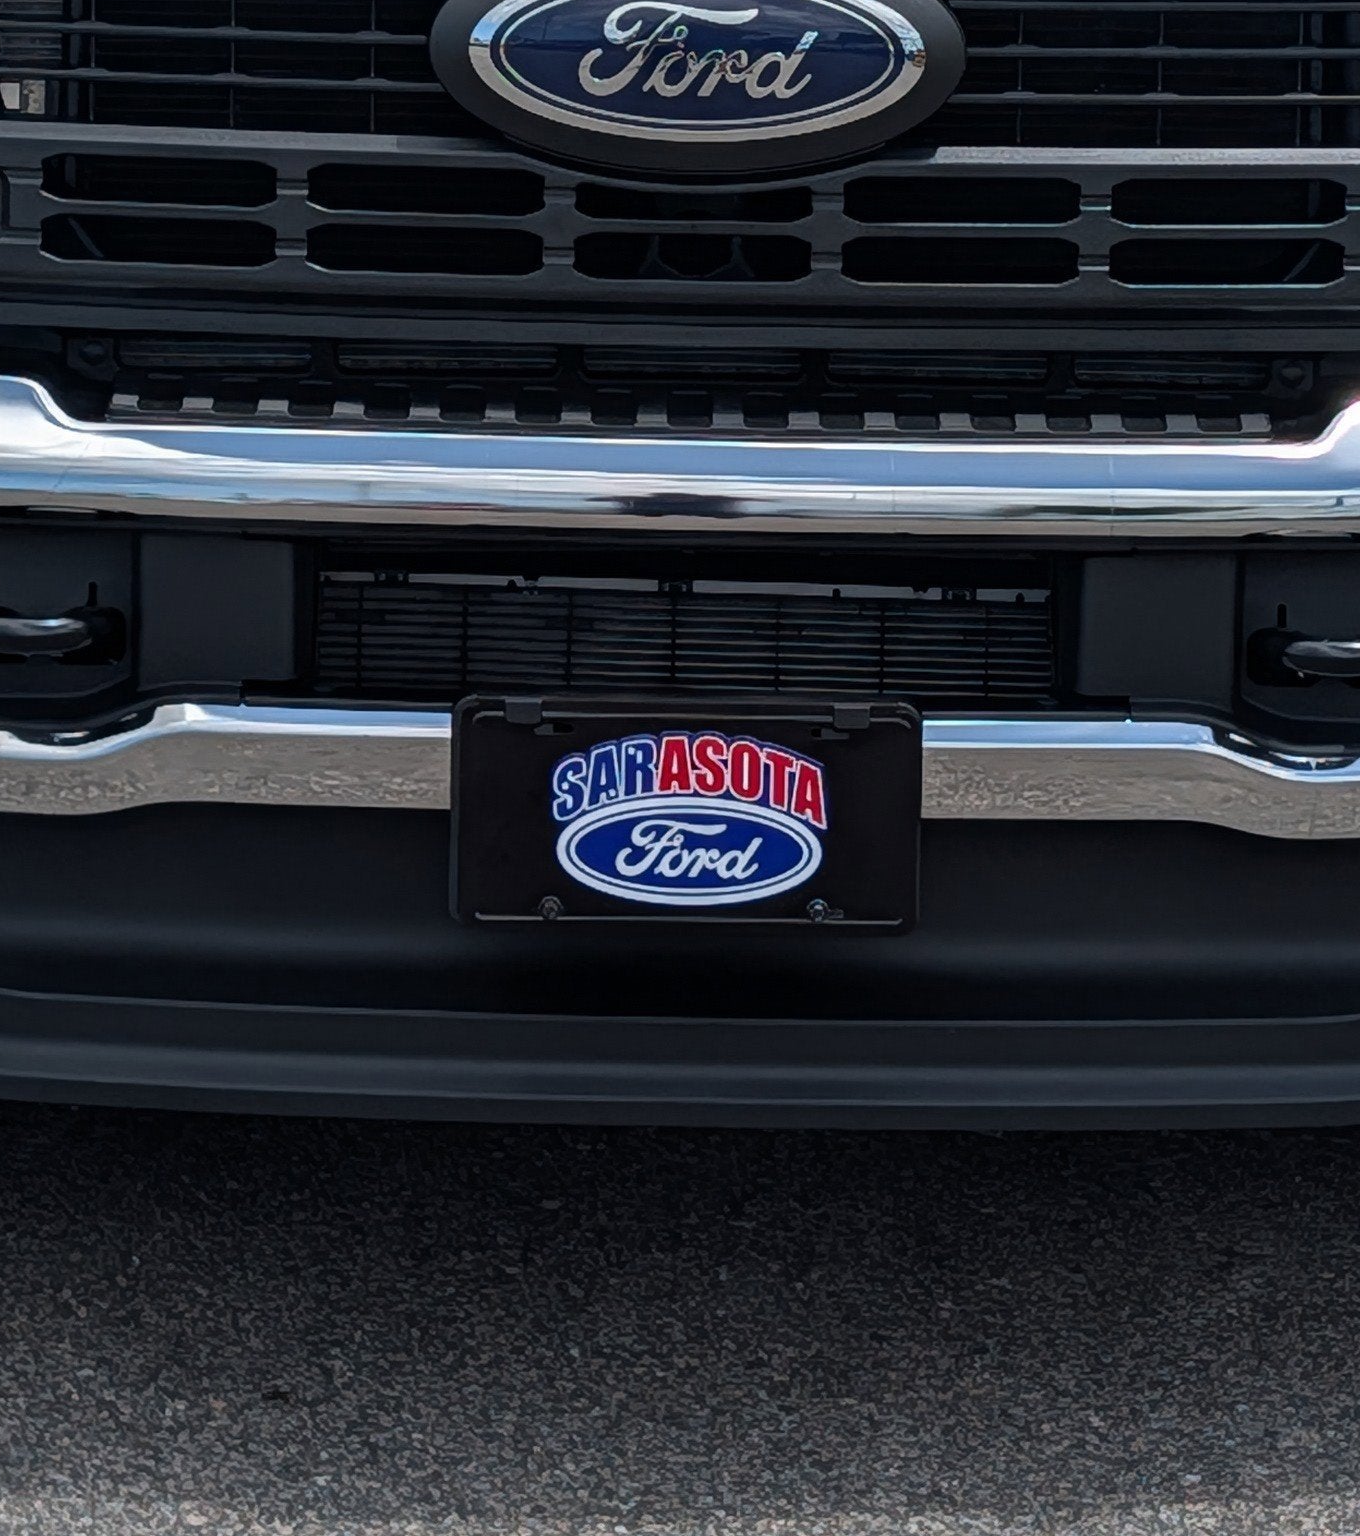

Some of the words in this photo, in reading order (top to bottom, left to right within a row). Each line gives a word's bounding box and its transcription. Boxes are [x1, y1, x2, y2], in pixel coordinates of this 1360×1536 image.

[578, 1, 820, 100] Ford
[552, 733, 829, 830] SARASOTA
[615, 818, 763, 881] Ford
